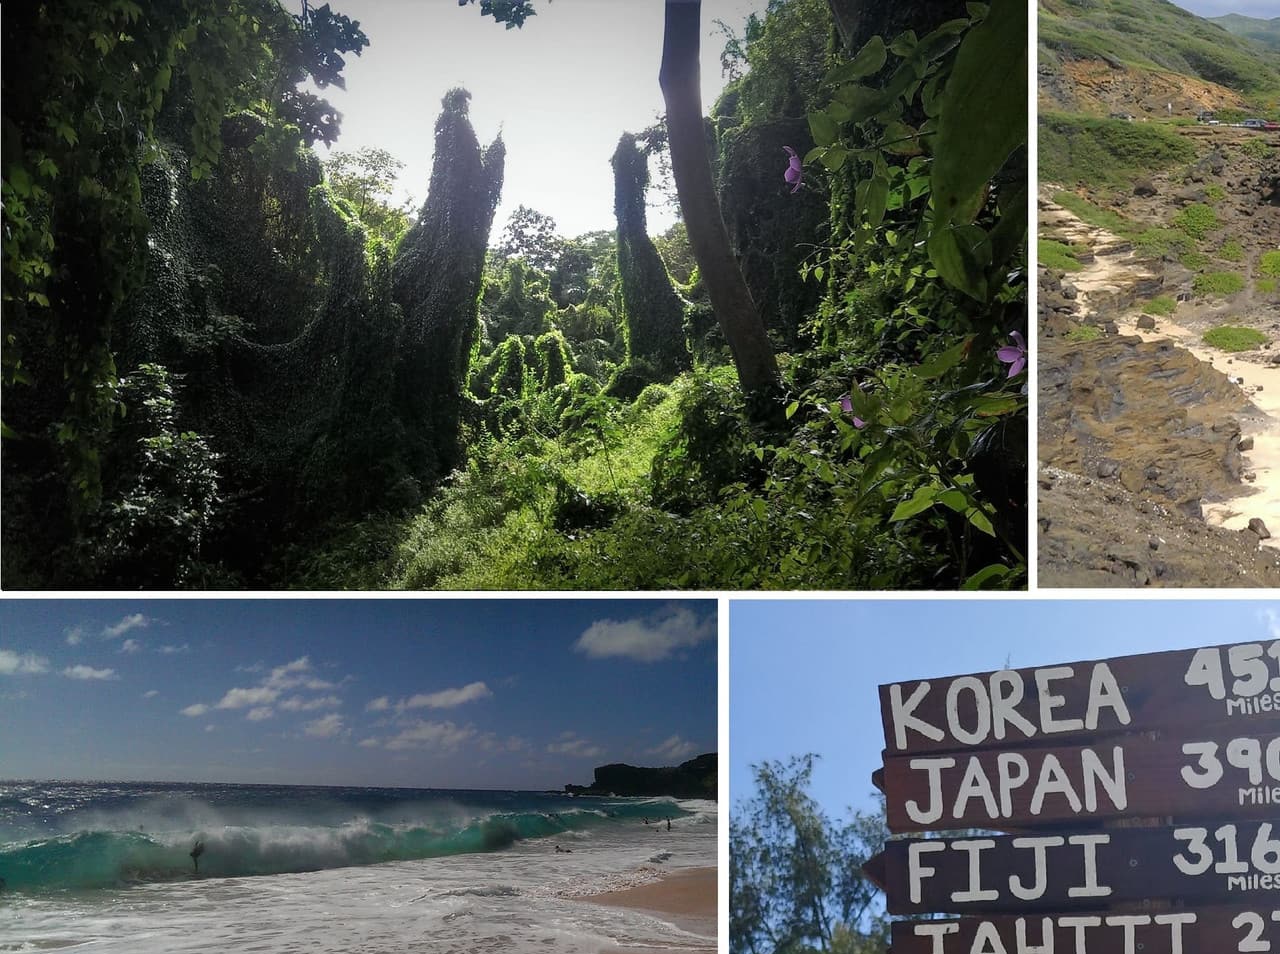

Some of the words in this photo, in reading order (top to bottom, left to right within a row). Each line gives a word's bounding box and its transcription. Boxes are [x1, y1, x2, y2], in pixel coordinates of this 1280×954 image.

[890, 663, 1131, 749] KOREA
[906, 746, 1127, 823] JAPAN
[909, 835, 1112, 904] FIJI
